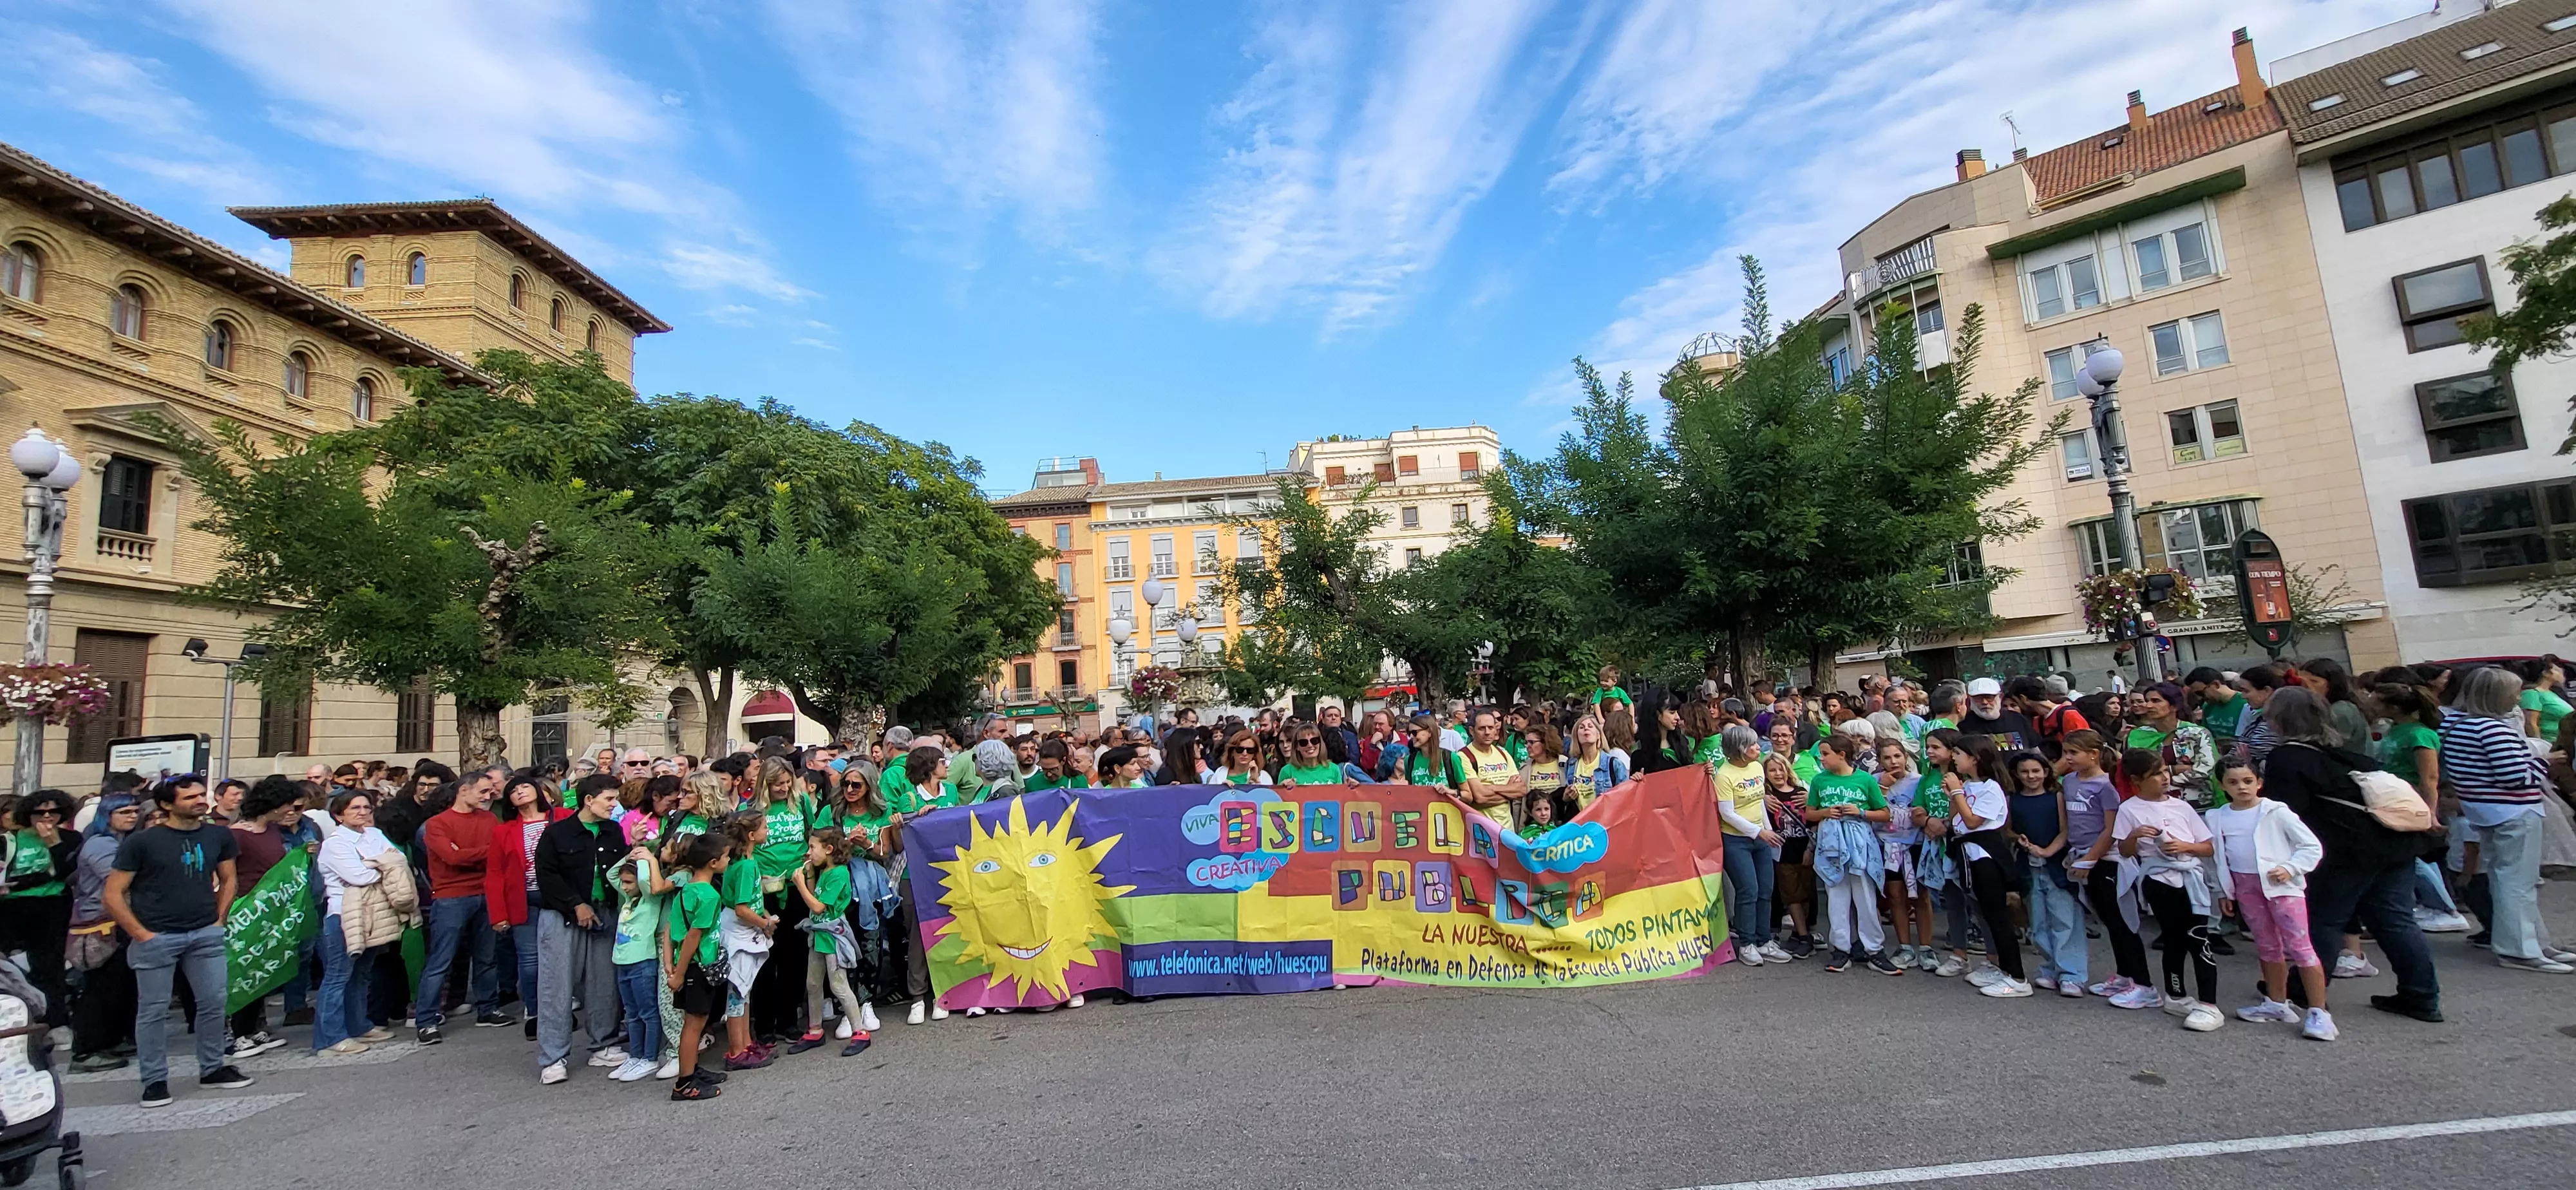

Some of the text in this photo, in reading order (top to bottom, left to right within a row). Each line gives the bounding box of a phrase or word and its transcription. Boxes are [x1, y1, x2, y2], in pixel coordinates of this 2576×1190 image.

[1186, 814, 1220, 833] VIVA
[1225, 807, 1497, 858] ESCUELA
[1196, 856, 1283, 882] CREATIVA
[1422, 923, 1444, 943] LA
[1452, 924, 1530, 956] NUESTRA
[1586, 920, 1636, 953] TODOS
[1361, 948, 1439, 976] Plataforma
[1446, 958, 1463, 980] en
[1468, 954, 1526, 982] Defensa
[1534, 958, 1549, 979] de
[1620, 946, 1676, 976] Pública
